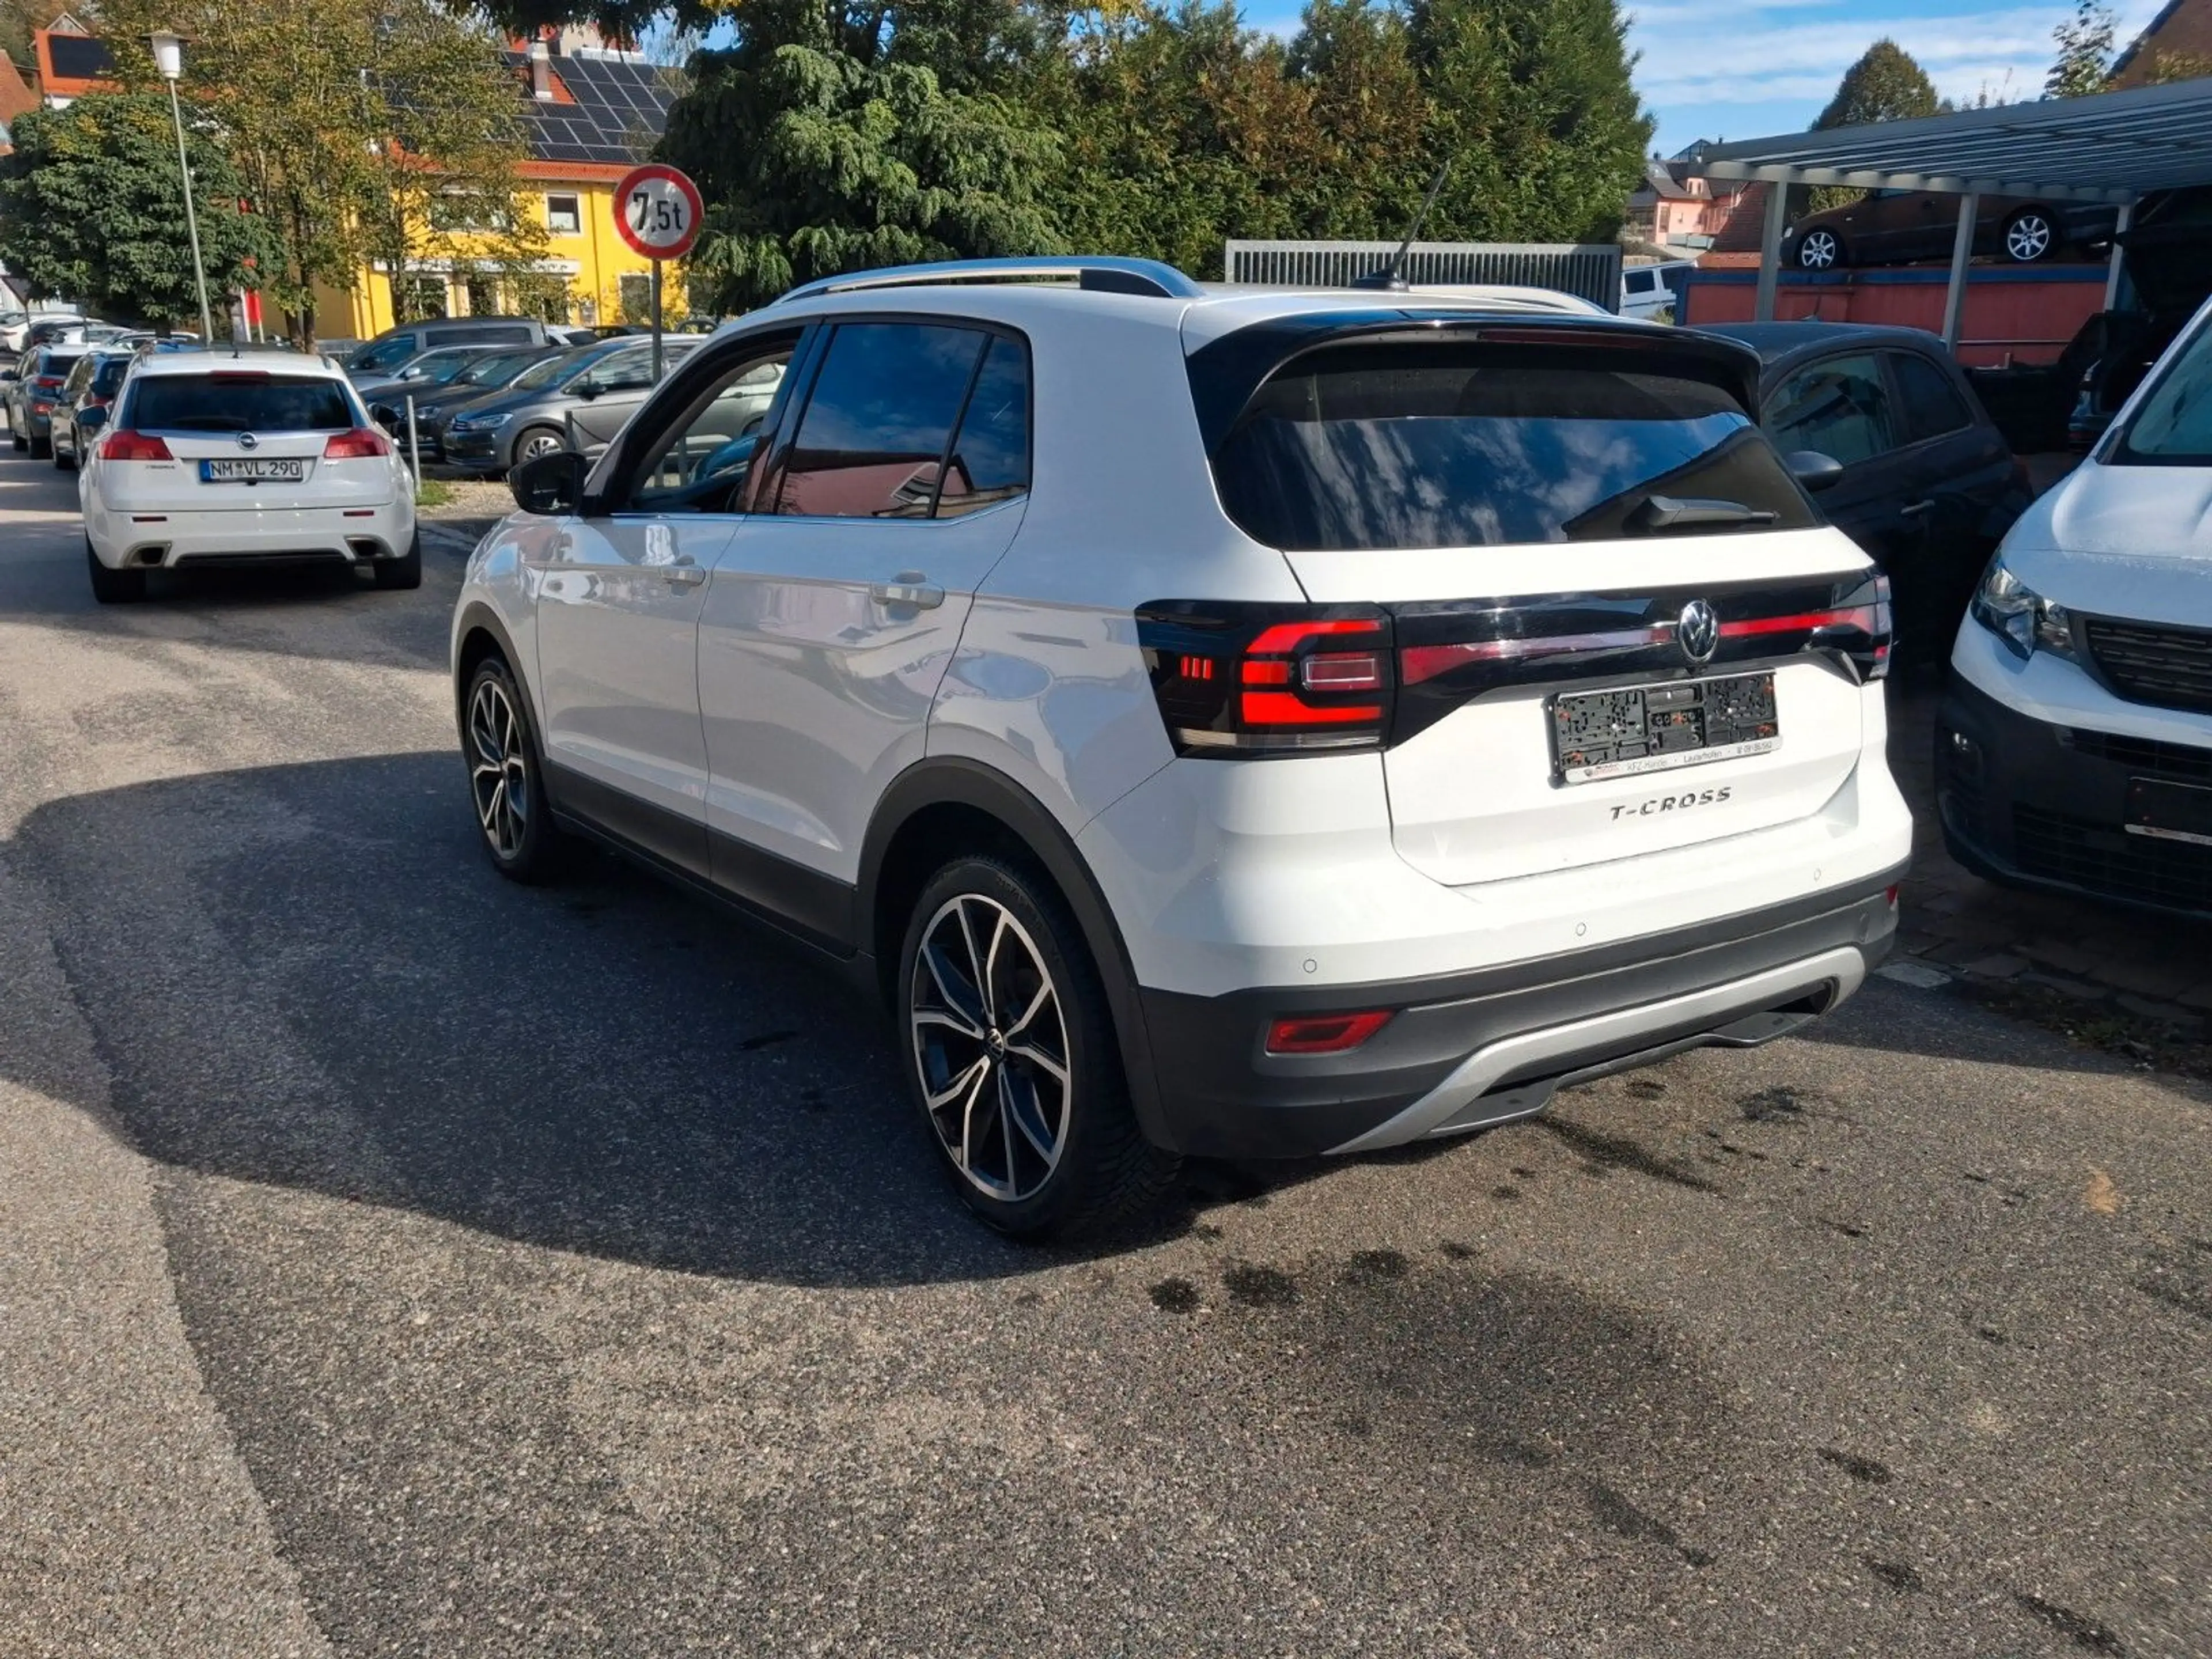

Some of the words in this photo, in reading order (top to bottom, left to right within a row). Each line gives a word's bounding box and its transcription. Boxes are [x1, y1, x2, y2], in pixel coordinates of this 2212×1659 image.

[211, 461, 233, 476] NM
[244, 461, 265, 475] VL
[269, 461, 299, 475] 290
[1611, 786, 1732, 820] T-CROSS
